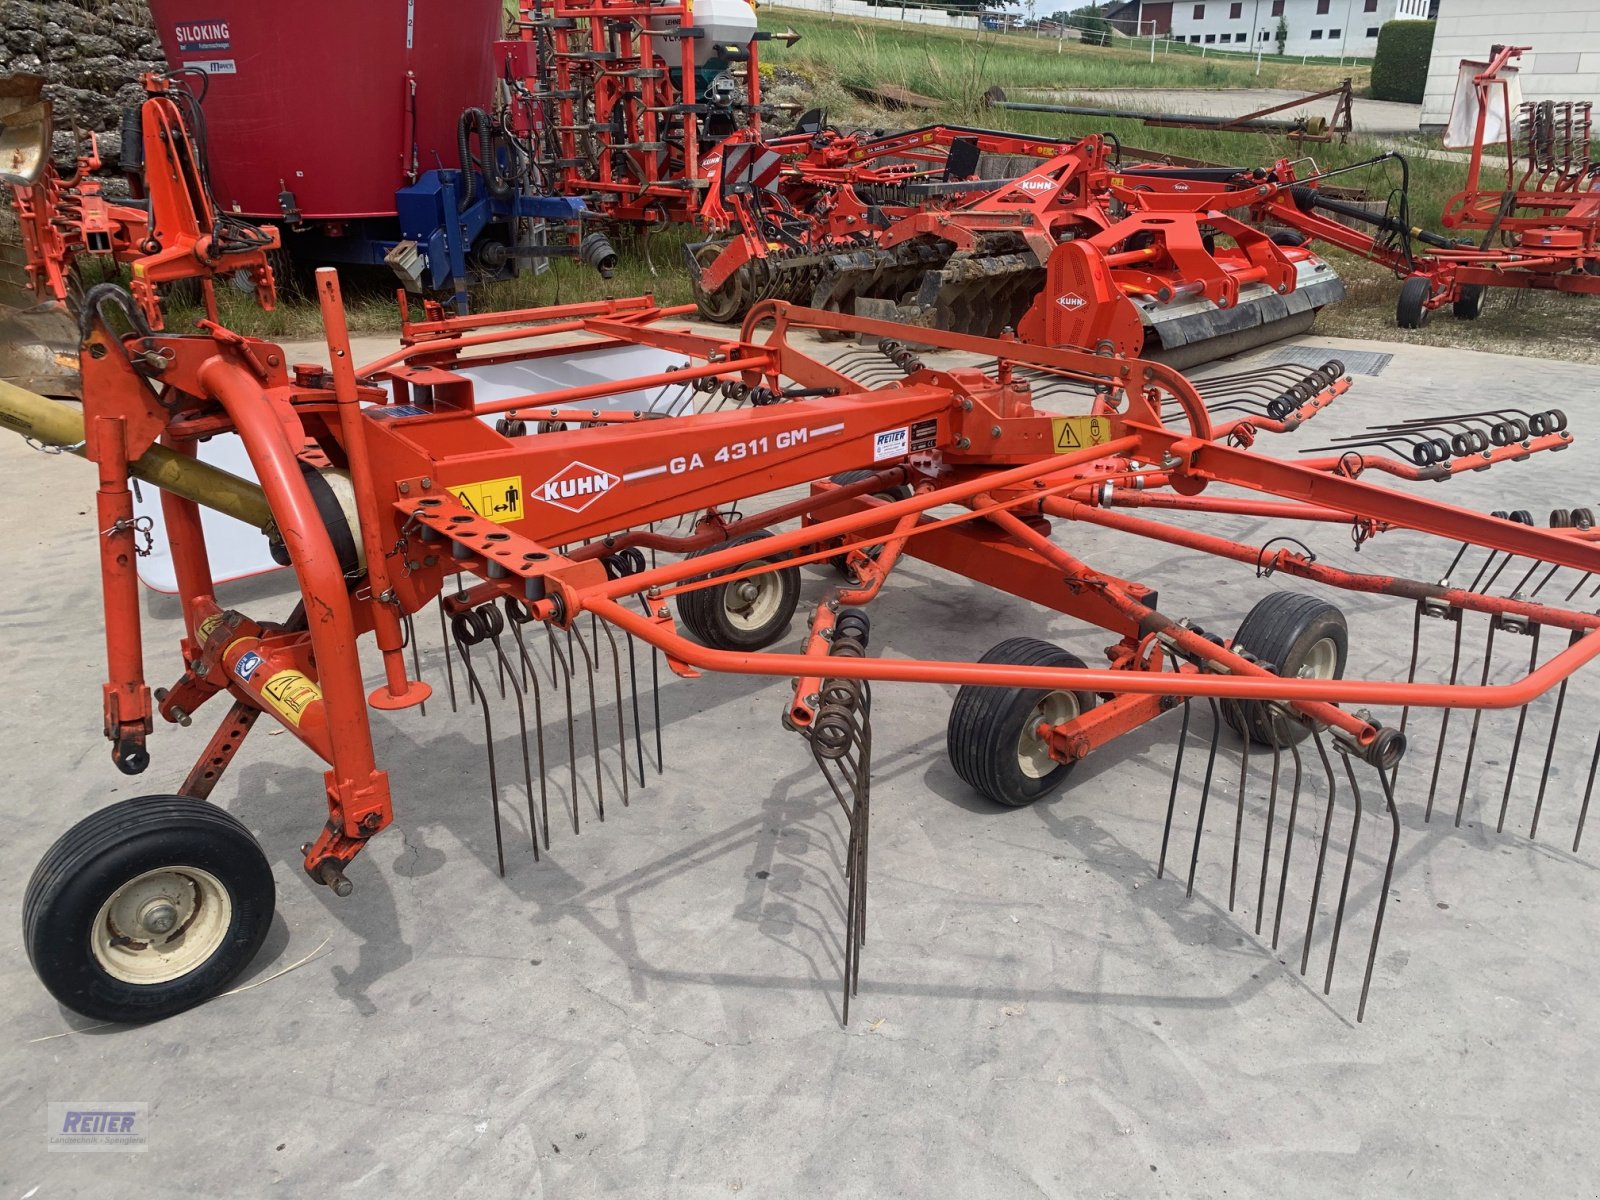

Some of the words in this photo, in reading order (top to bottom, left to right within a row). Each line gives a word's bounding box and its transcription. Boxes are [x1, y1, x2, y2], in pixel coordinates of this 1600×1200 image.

[176, 23, 230, 42] SILOKING
[1021, 180, 1052, 190] KUHN
[1060, 297, 1083, 306] KUHN
[877, 429, 906, 446] REITER
[669, 453, 704, 475] GA
[714, 437, 768, 463] 4311
[776, 427, 807, 449] GM
[543, 473, 609, 502] KUHN
